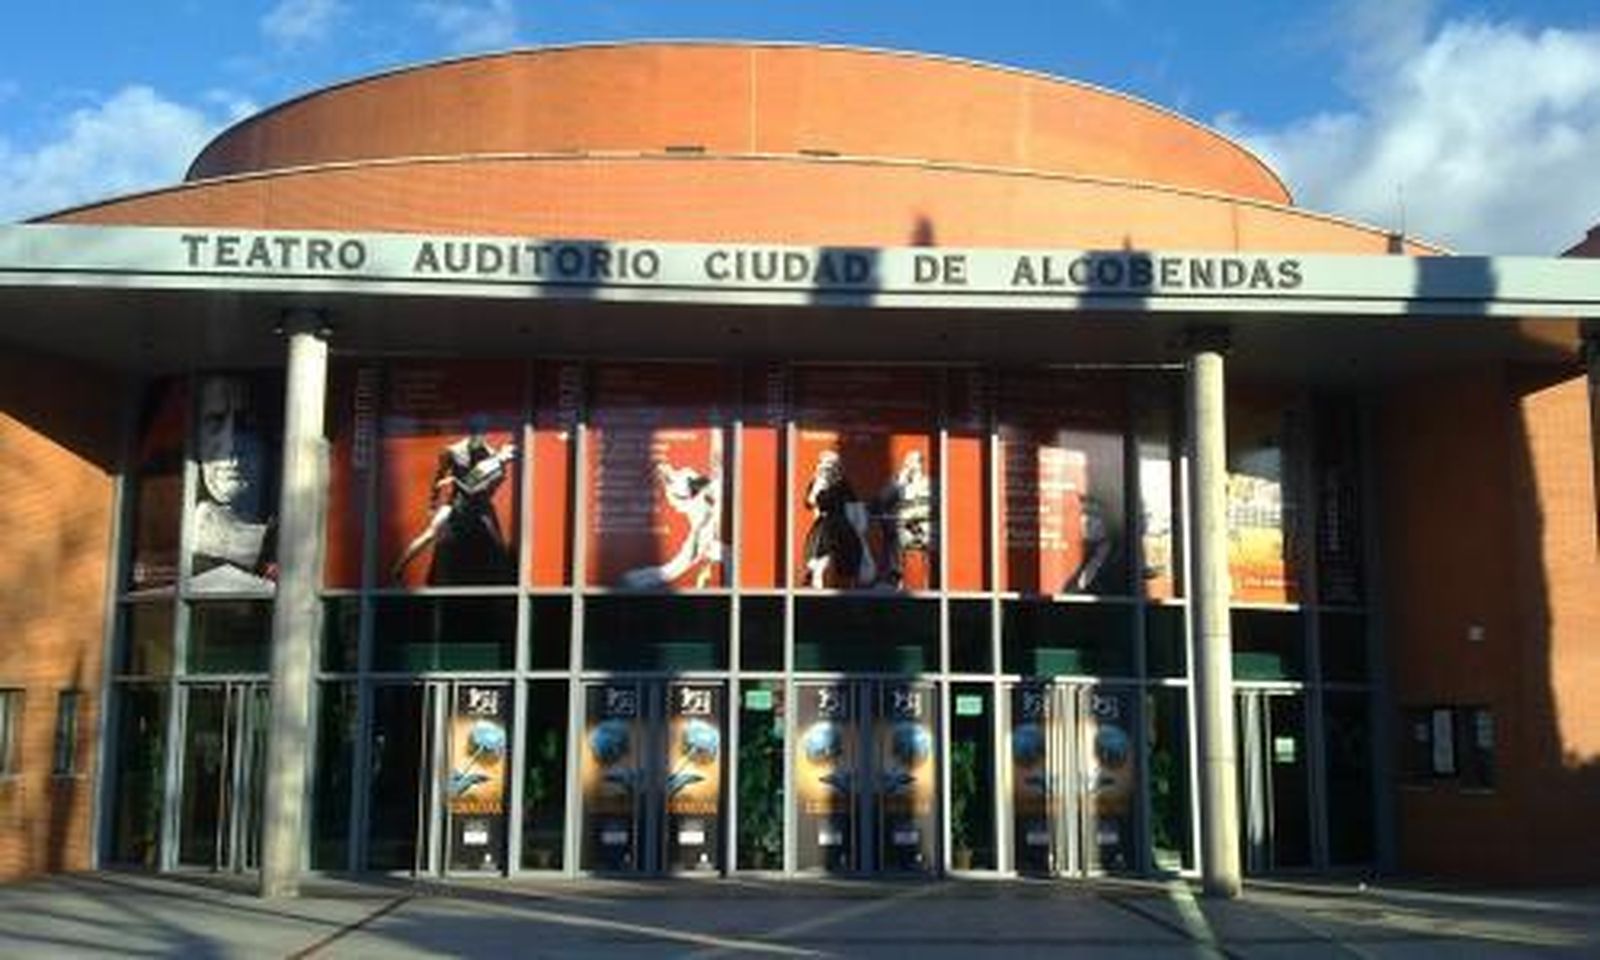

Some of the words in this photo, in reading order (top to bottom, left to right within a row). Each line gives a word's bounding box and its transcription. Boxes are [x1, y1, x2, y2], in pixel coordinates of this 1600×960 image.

[181, 234, 367, 271] TEATRO
[414, 242, 660, 280] AUDITORIO
[705, 248, 869, 284] CIUDAD
[914, 254, 967, 287] DE
[1011, 255, 1304, 290] ALCOBENDAS
